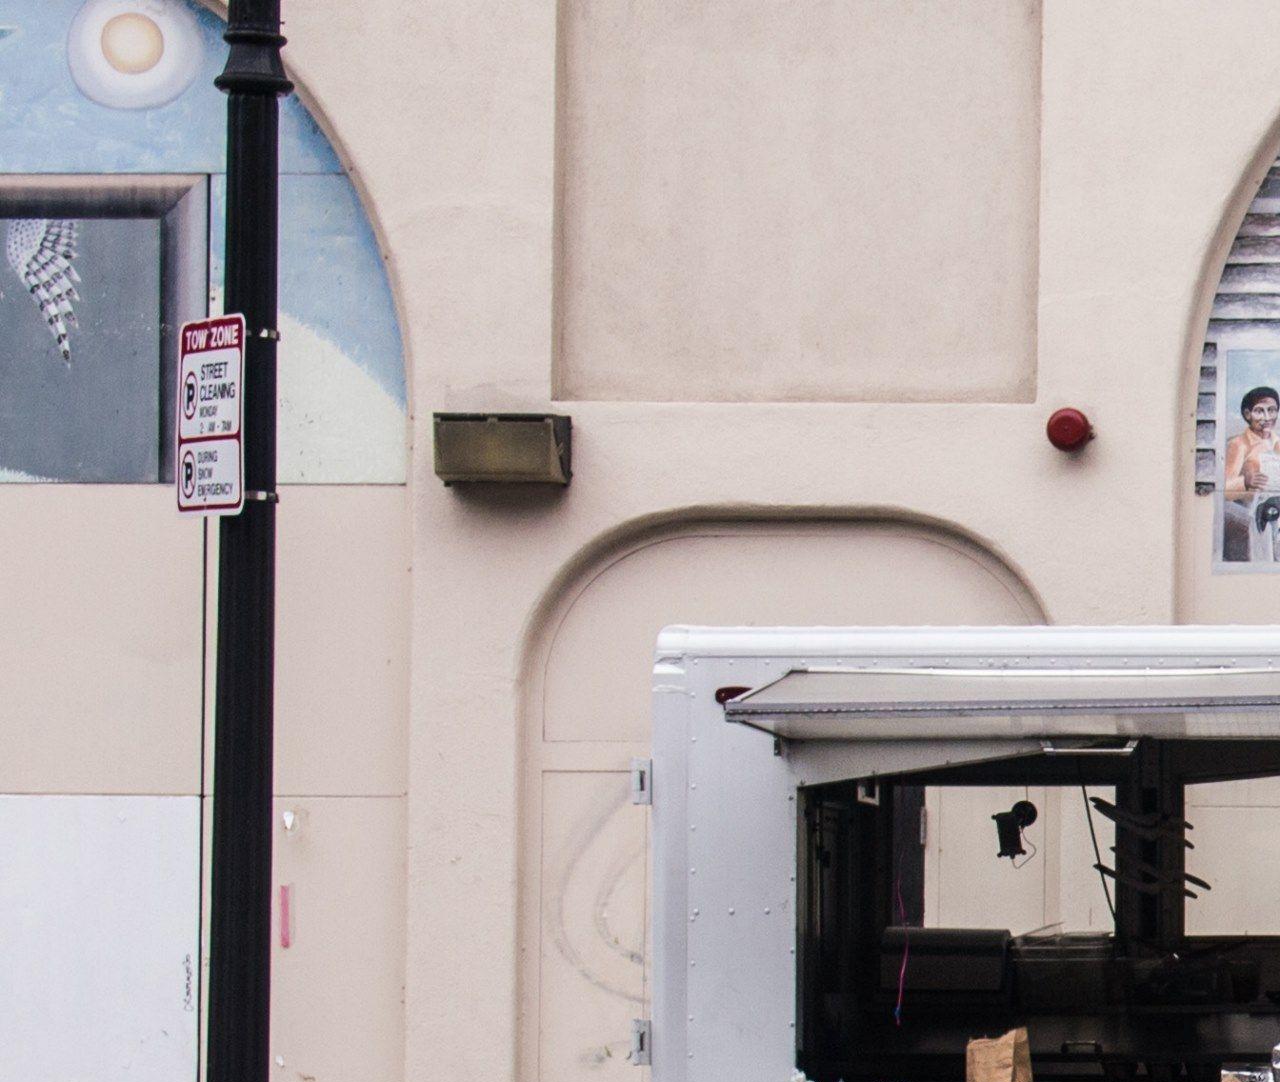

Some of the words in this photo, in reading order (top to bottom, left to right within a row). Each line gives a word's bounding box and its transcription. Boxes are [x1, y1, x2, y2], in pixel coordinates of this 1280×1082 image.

[185, 329, 209, 351] TOW
[210, 324, 239, 347] ZONE
[200, 361, 228, 381] STREET
[200, 382, 236, 401] CLEANING
[199, 405, 218, 418] MONDAY
[198, 450, 218, 464] DURING
[198, 467, 213, 480] SNOW
[198, 482, 233, 498] EMERGENCY
